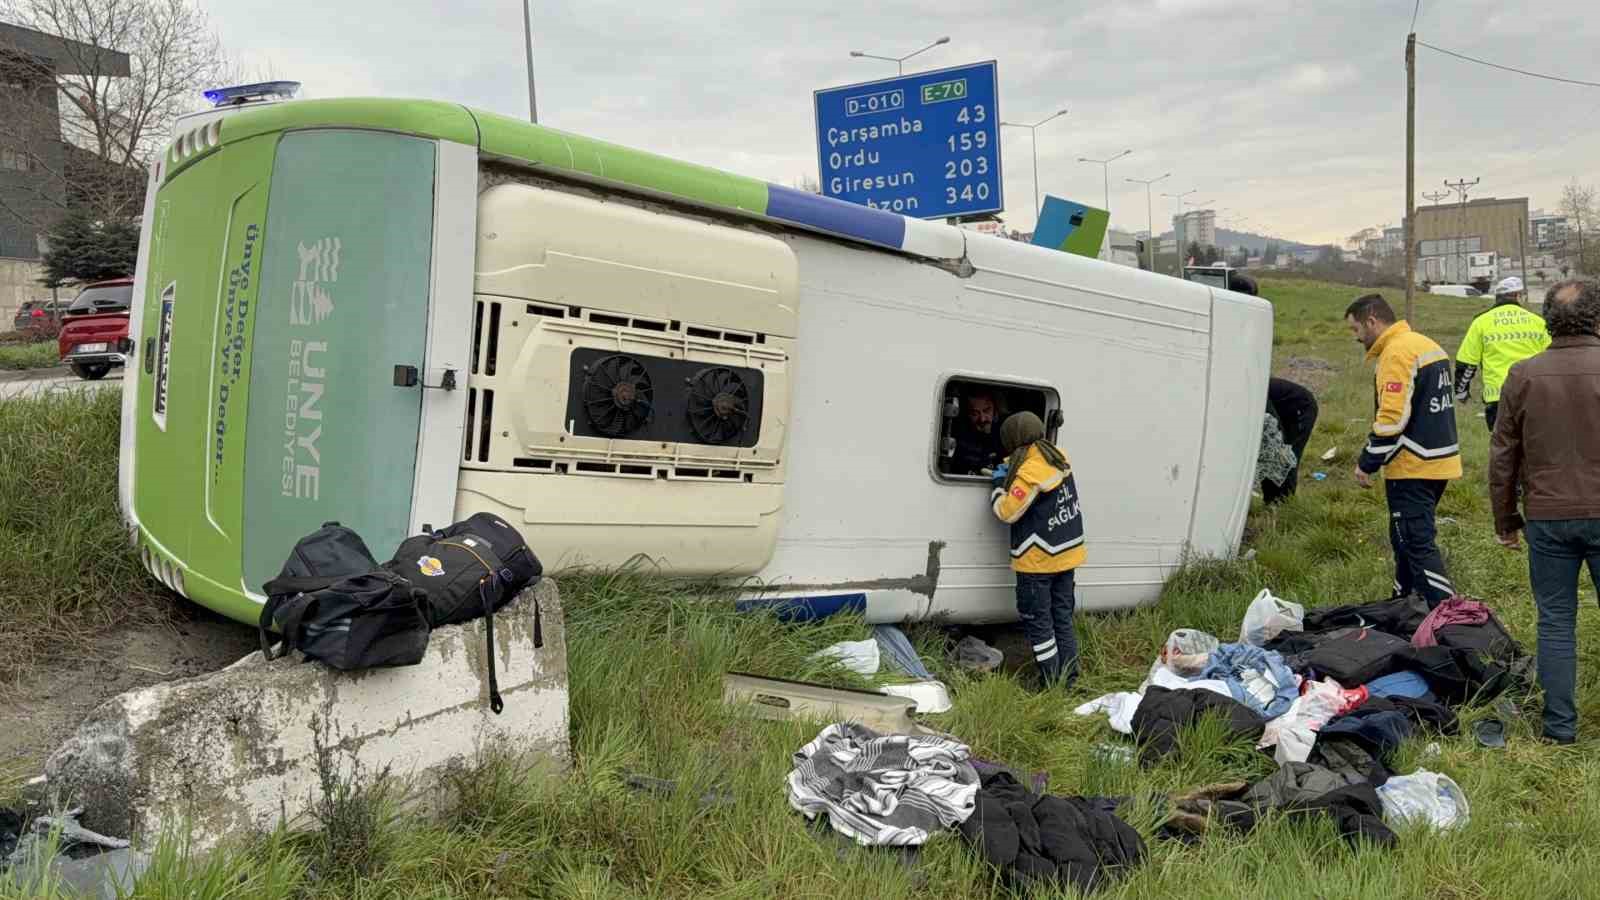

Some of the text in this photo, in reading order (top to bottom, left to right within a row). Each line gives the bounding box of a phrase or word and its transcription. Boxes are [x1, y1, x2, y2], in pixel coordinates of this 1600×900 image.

[849, 92, 901, 114] D-010
[924, 82, 964, 101] E-70
[827, 104, 986, 146] Çarşamba 43
[829, 131, 987, 170] Ordu 159
[831, 156, 988, 194] Giresun 203
[946, 182, 990, 204] 340
[240, 223, 258, 290] Ünye
[296, 340, 329, 501] ÜNYE
